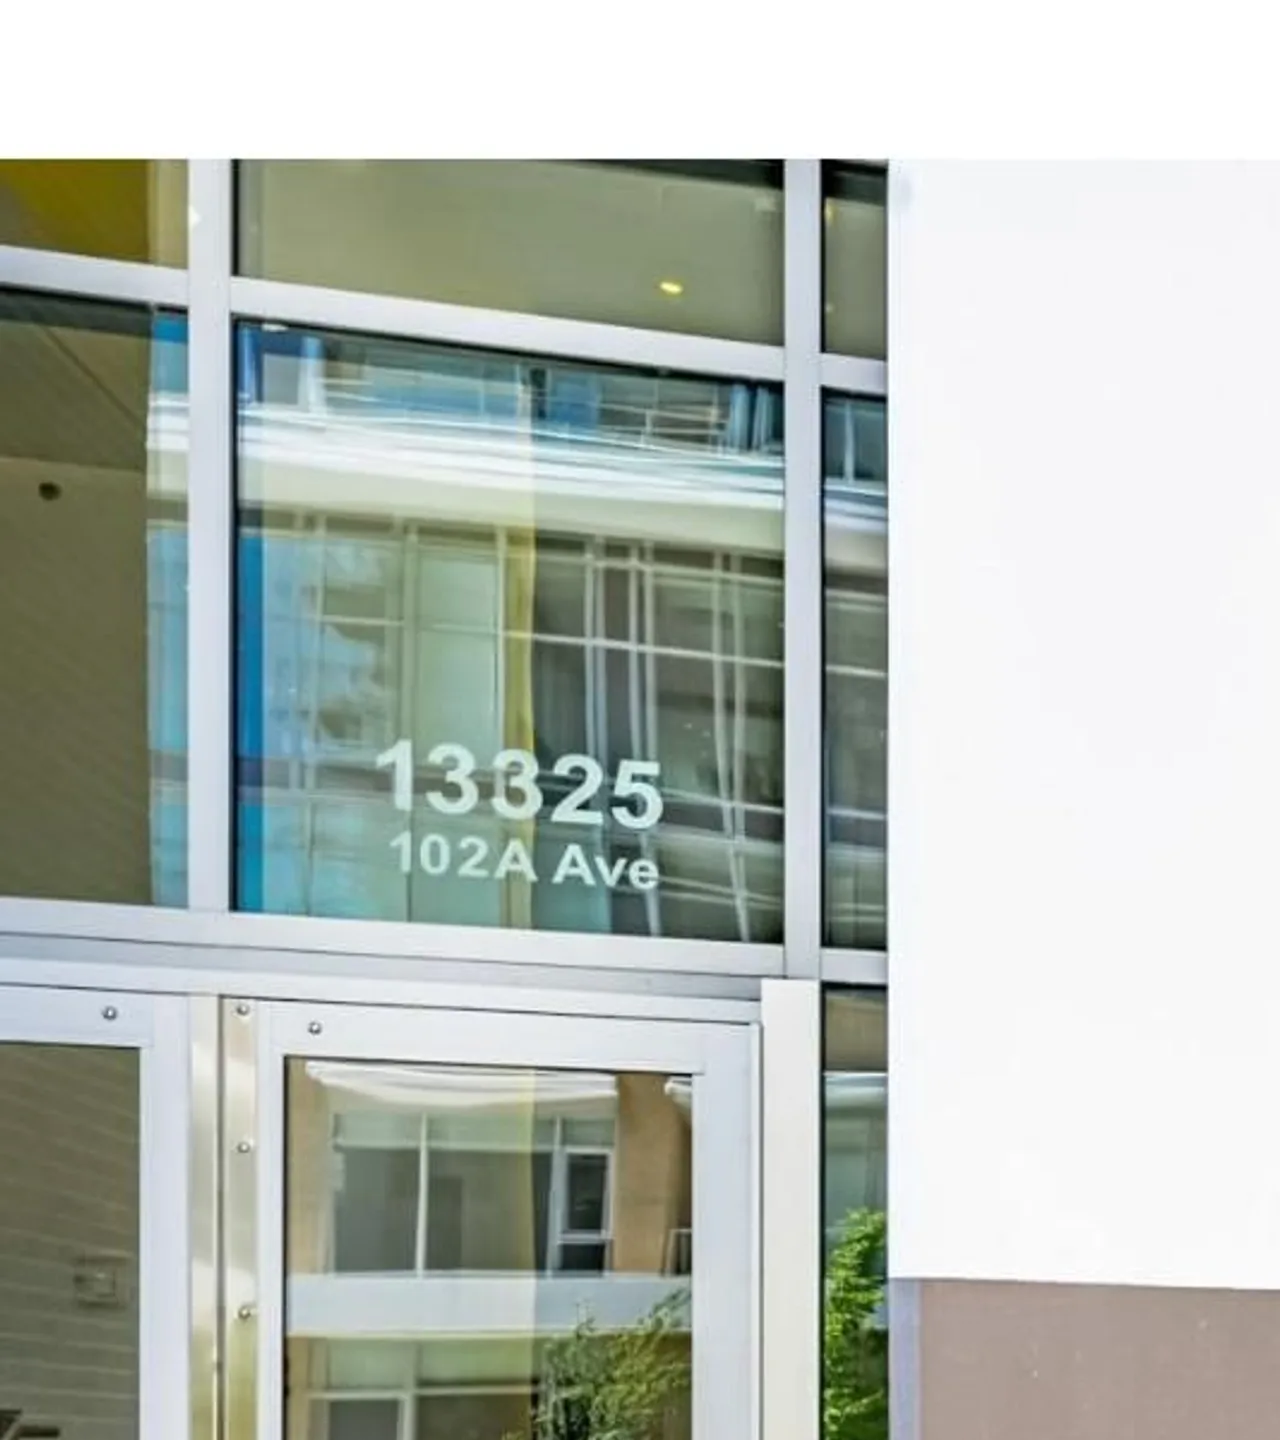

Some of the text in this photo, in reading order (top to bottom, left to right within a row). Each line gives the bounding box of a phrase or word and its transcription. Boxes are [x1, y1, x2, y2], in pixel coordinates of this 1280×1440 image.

[376, 739, 664, 830] 13325
[389, 830, 660, 890] 102A Ave
